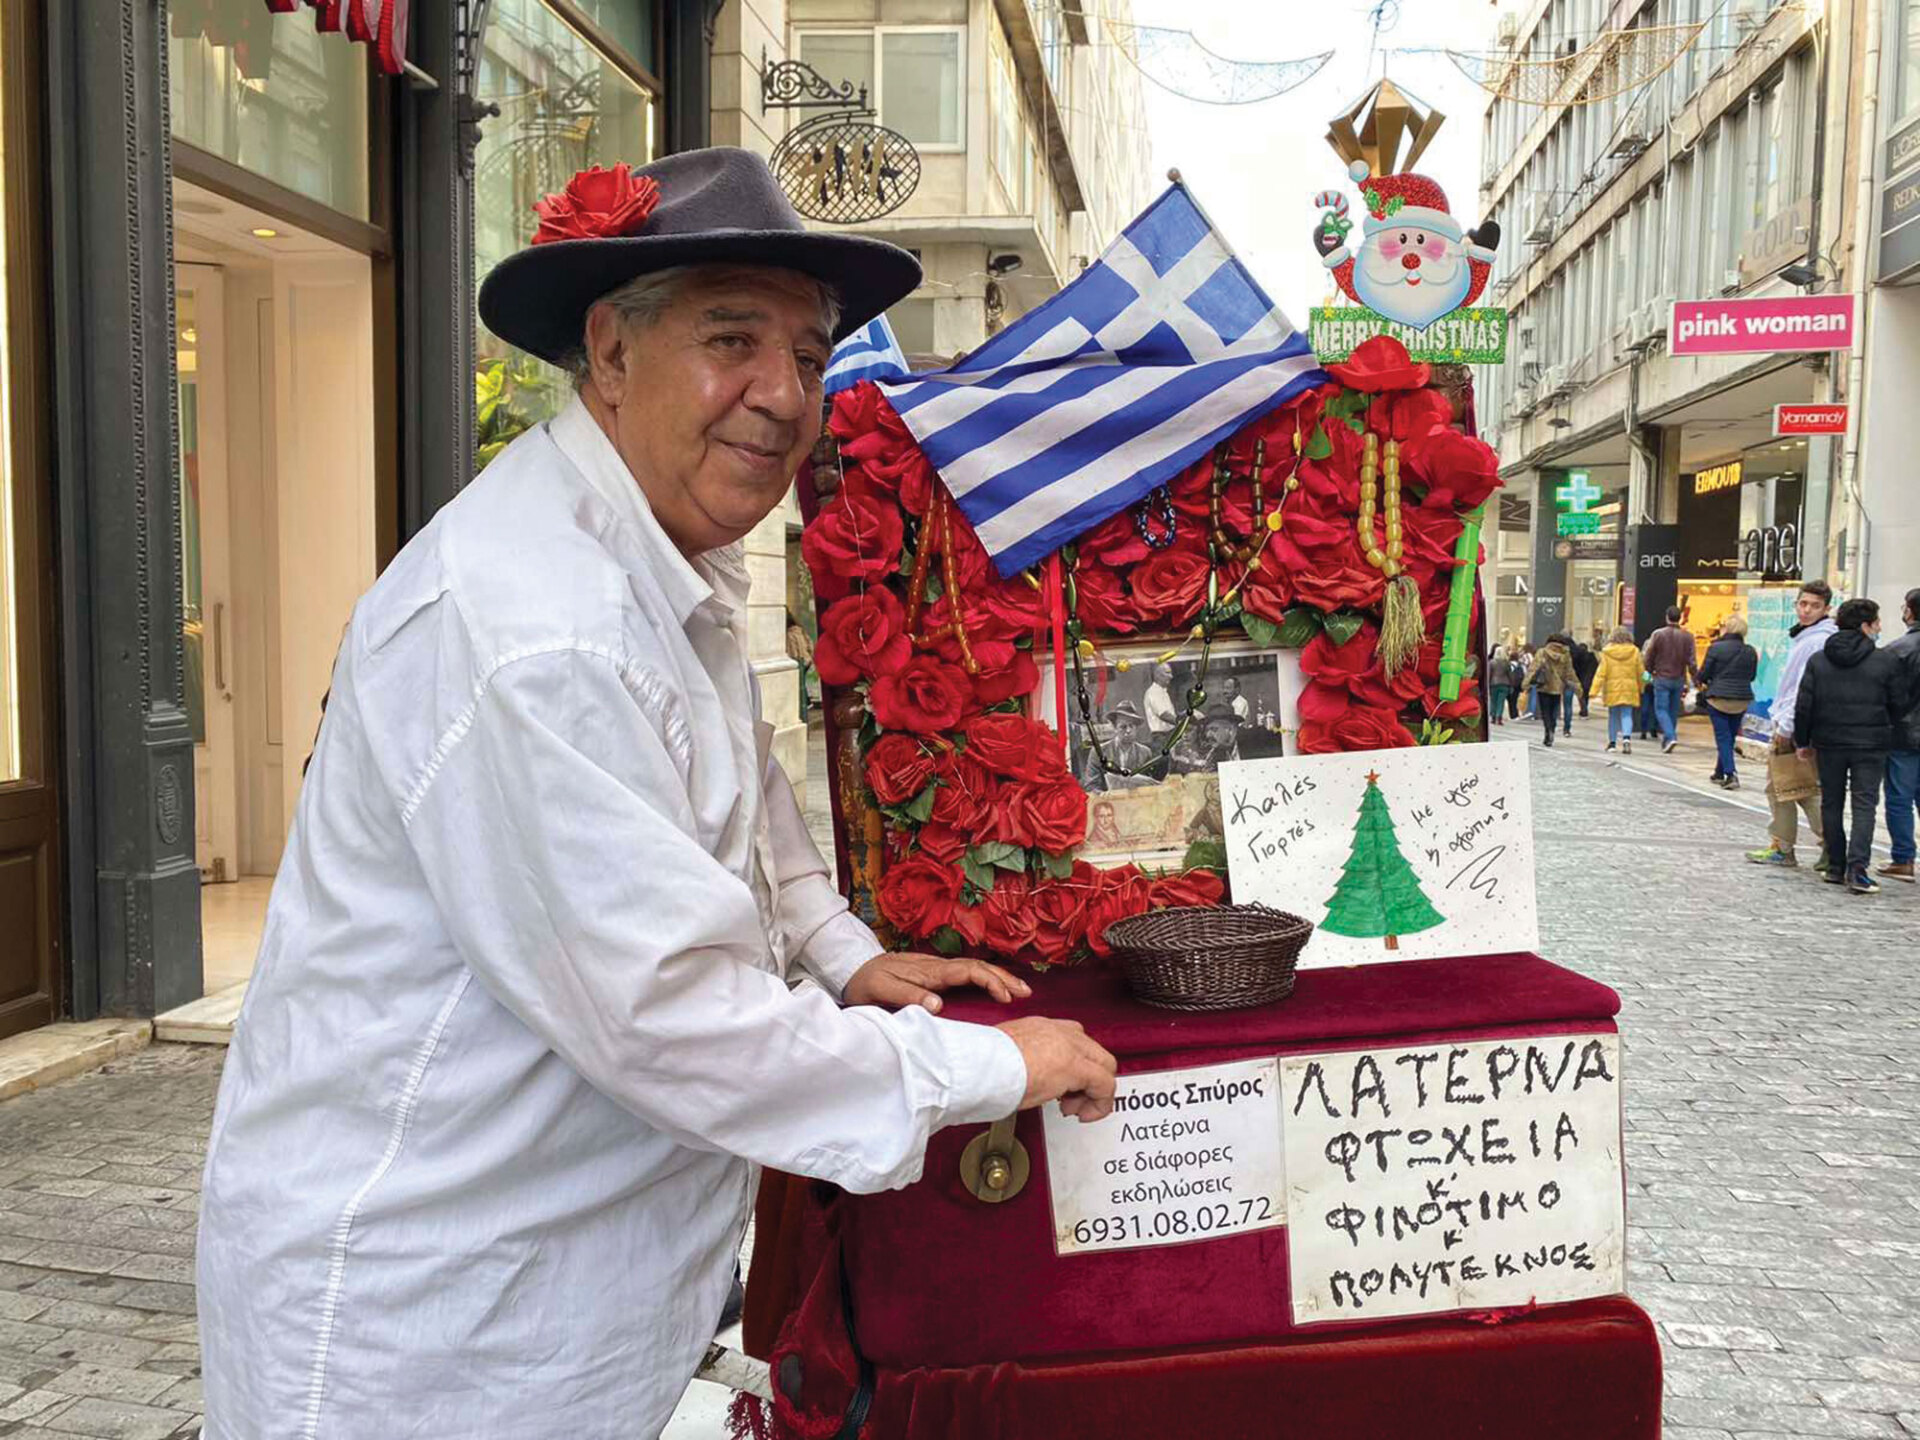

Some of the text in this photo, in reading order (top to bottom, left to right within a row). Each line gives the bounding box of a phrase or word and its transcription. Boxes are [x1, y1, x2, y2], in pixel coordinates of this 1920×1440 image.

[1679, 312, 1846, 342] pink woman
[1781, 411, 1846, 425] yamamay
[1745, 504, 1803, 574] anel
[1231, 775, 1317, 825] Καλές
[1248, 819, 1315, 863] Γιορτές
[1114, 1078, 1264, 1112] πόσος Σπύρος
[1294, 1039, 1614, 1119] ΛΑΤΕΡΝΑ
[1120, 1118, 1211, 1142] Λατέρνα
[1103, 1146, 1234, 1175] σε διάφορες
[1111, 1176, 1233, 1205] εκδηλώσεις
[1074, 1196, 1273, 1244] 6931.08.02.72
